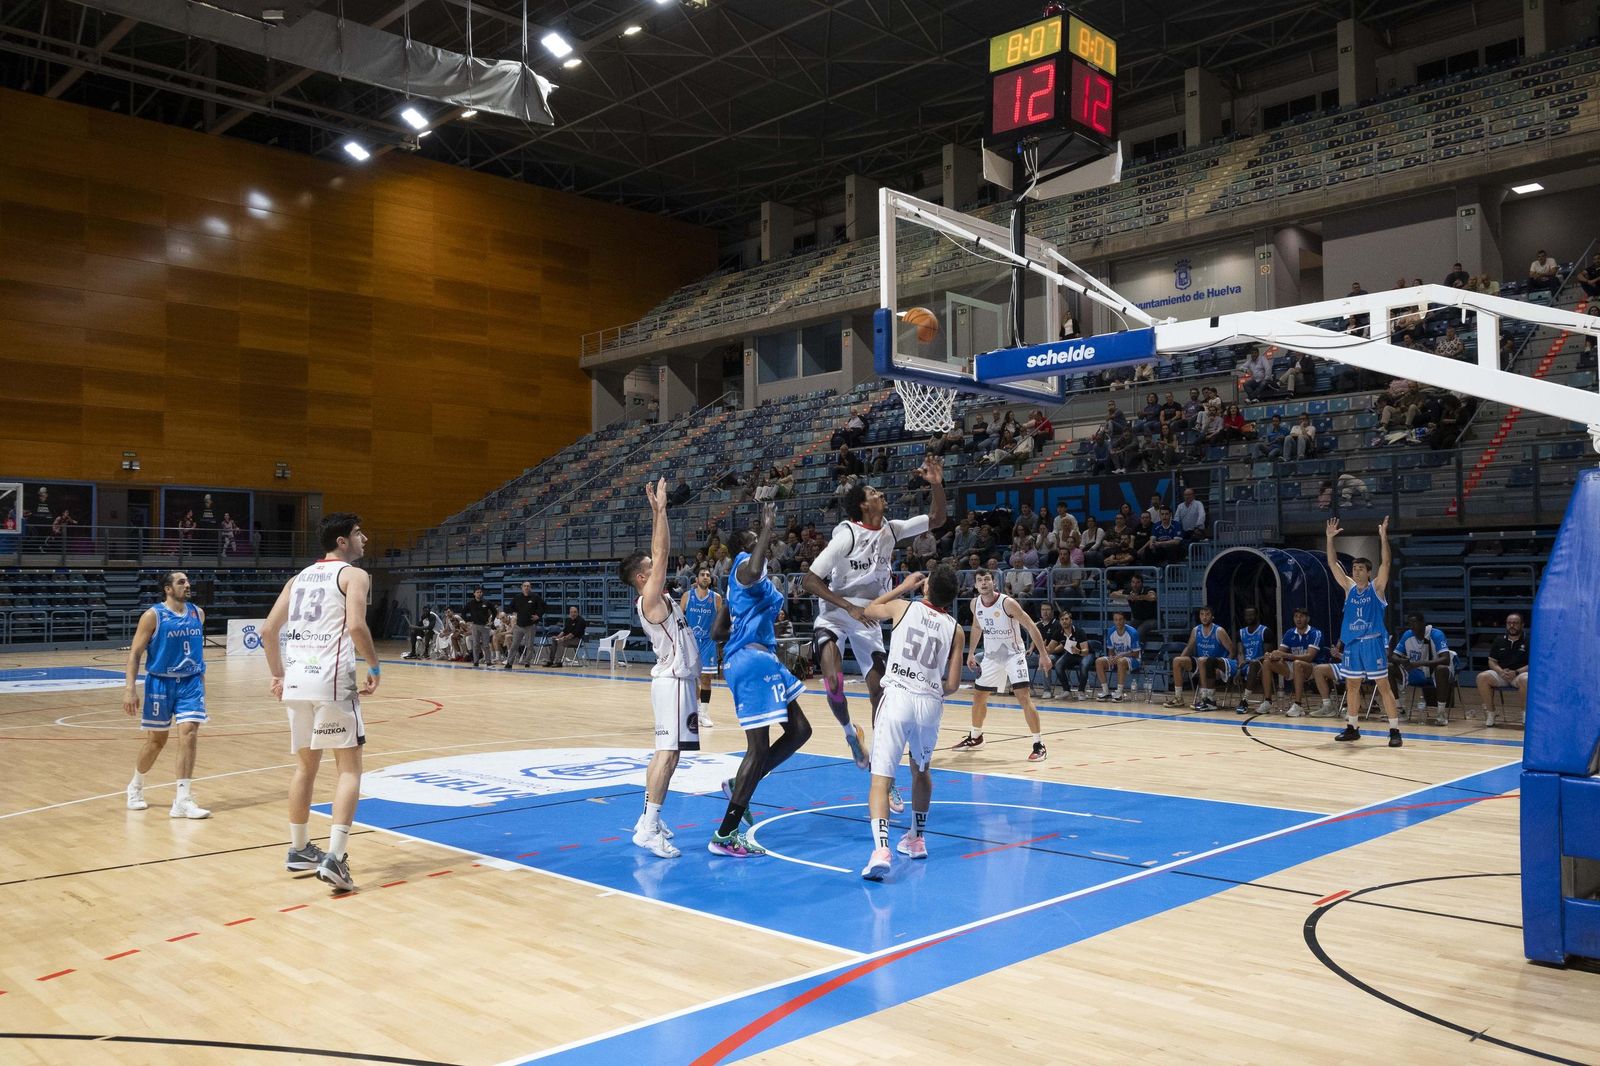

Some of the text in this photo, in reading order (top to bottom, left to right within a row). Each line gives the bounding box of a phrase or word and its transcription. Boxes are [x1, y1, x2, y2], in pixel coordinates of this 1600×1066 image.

[1007, 21, 1061, 64] 8:07
[1079, 28, 1115, 71] 8:07
[1013, 64, 1056, 123] 12
[1083, 75, 1112, 132] 12
[1193, 290, 1205, 300] de
[1207, 285, 1242, 299] Huelva
[1027, 344, 1096, 368] schelde
[966, 478, 1173, 524] HUELV
[290, 588, 325, 622] 13
[984, 618, 994, 626] 33
[183, 641, 190, 655] 9
[902, 626, 943, 669] 50
[1017, 669, 1028, 679] 33
[772, 683, 787, 703] 12
[152, 701, 160, 716] 9
[402, 772, 539, 800] HUELVA
